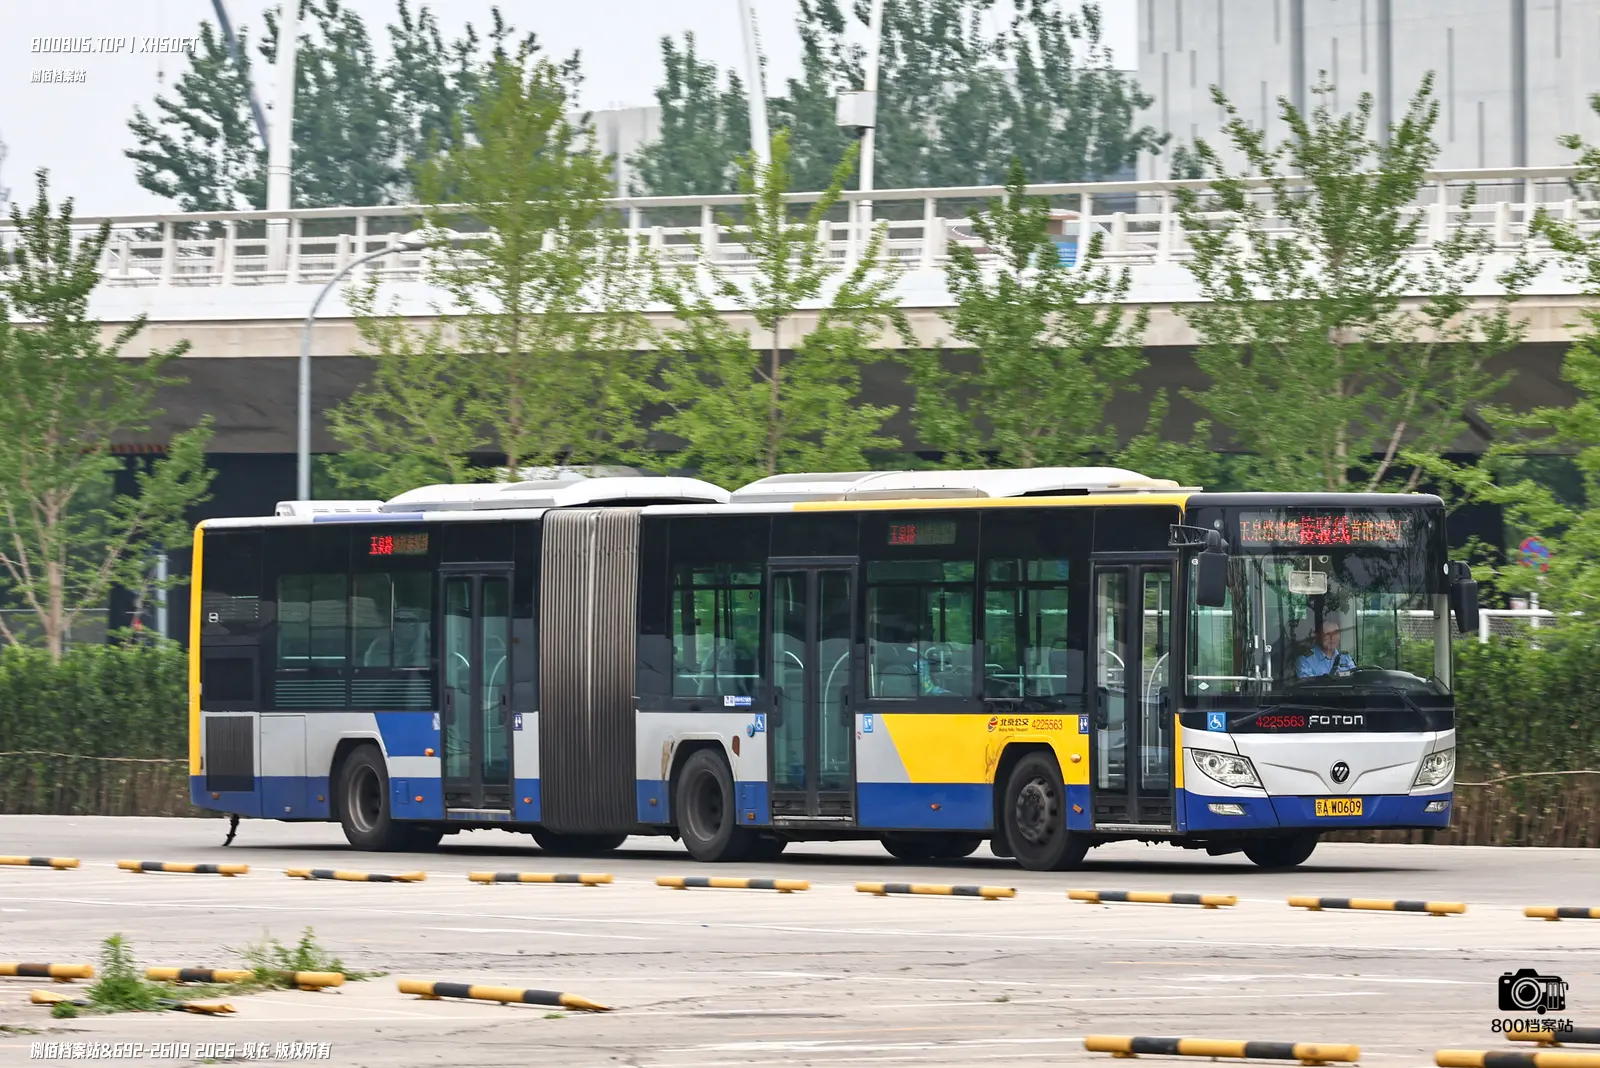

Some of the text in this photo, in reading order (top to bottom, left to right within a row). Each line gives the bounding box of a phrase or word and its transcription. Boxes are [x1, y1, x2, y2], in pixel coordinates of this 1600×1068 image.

[1000, 718, 1030, 727] 北京公交
[1032, 719, 1063, 731] 4225563
[1255, 715, 1305, 728] 4225563
[1308, 714, 1364, 727] FOTON
